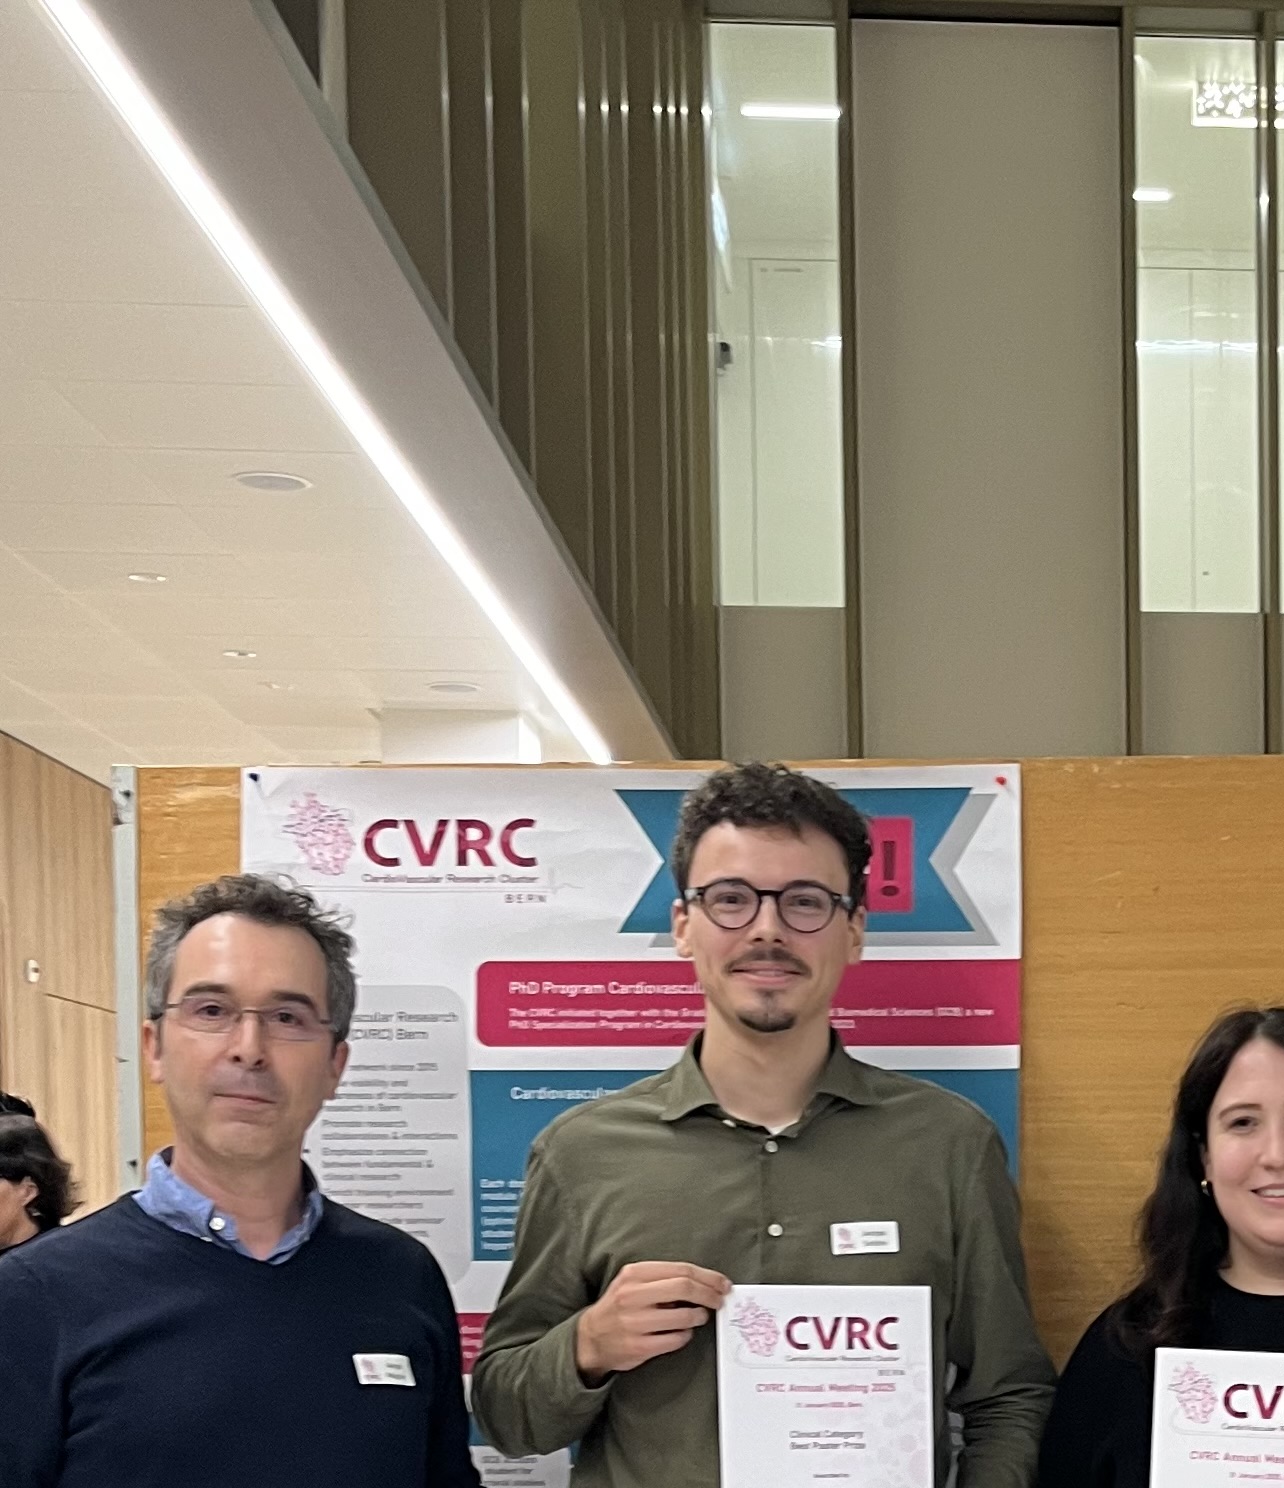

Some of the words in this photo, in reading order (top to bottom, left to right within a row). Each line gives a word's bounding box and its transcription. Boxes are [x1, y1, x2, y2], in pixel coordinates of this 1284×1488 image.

[363, 818, 539, 868] CVRC
[504, 893, 548, 904] BERN
[396, 1011, 459, 1023] Research
[785, 1316, 900, 1351] CVRC
[755, 1383, 786, 1392] CVRC
[788, 1383, 826, 1392] Annual
[828, 1383, 869, 1394] Meeting
[871, 1382, 897, 1392] 2025
[1189, 1450, 1220, 1460] CVRC
[1223, 1452, 1261, 1463] Annual
